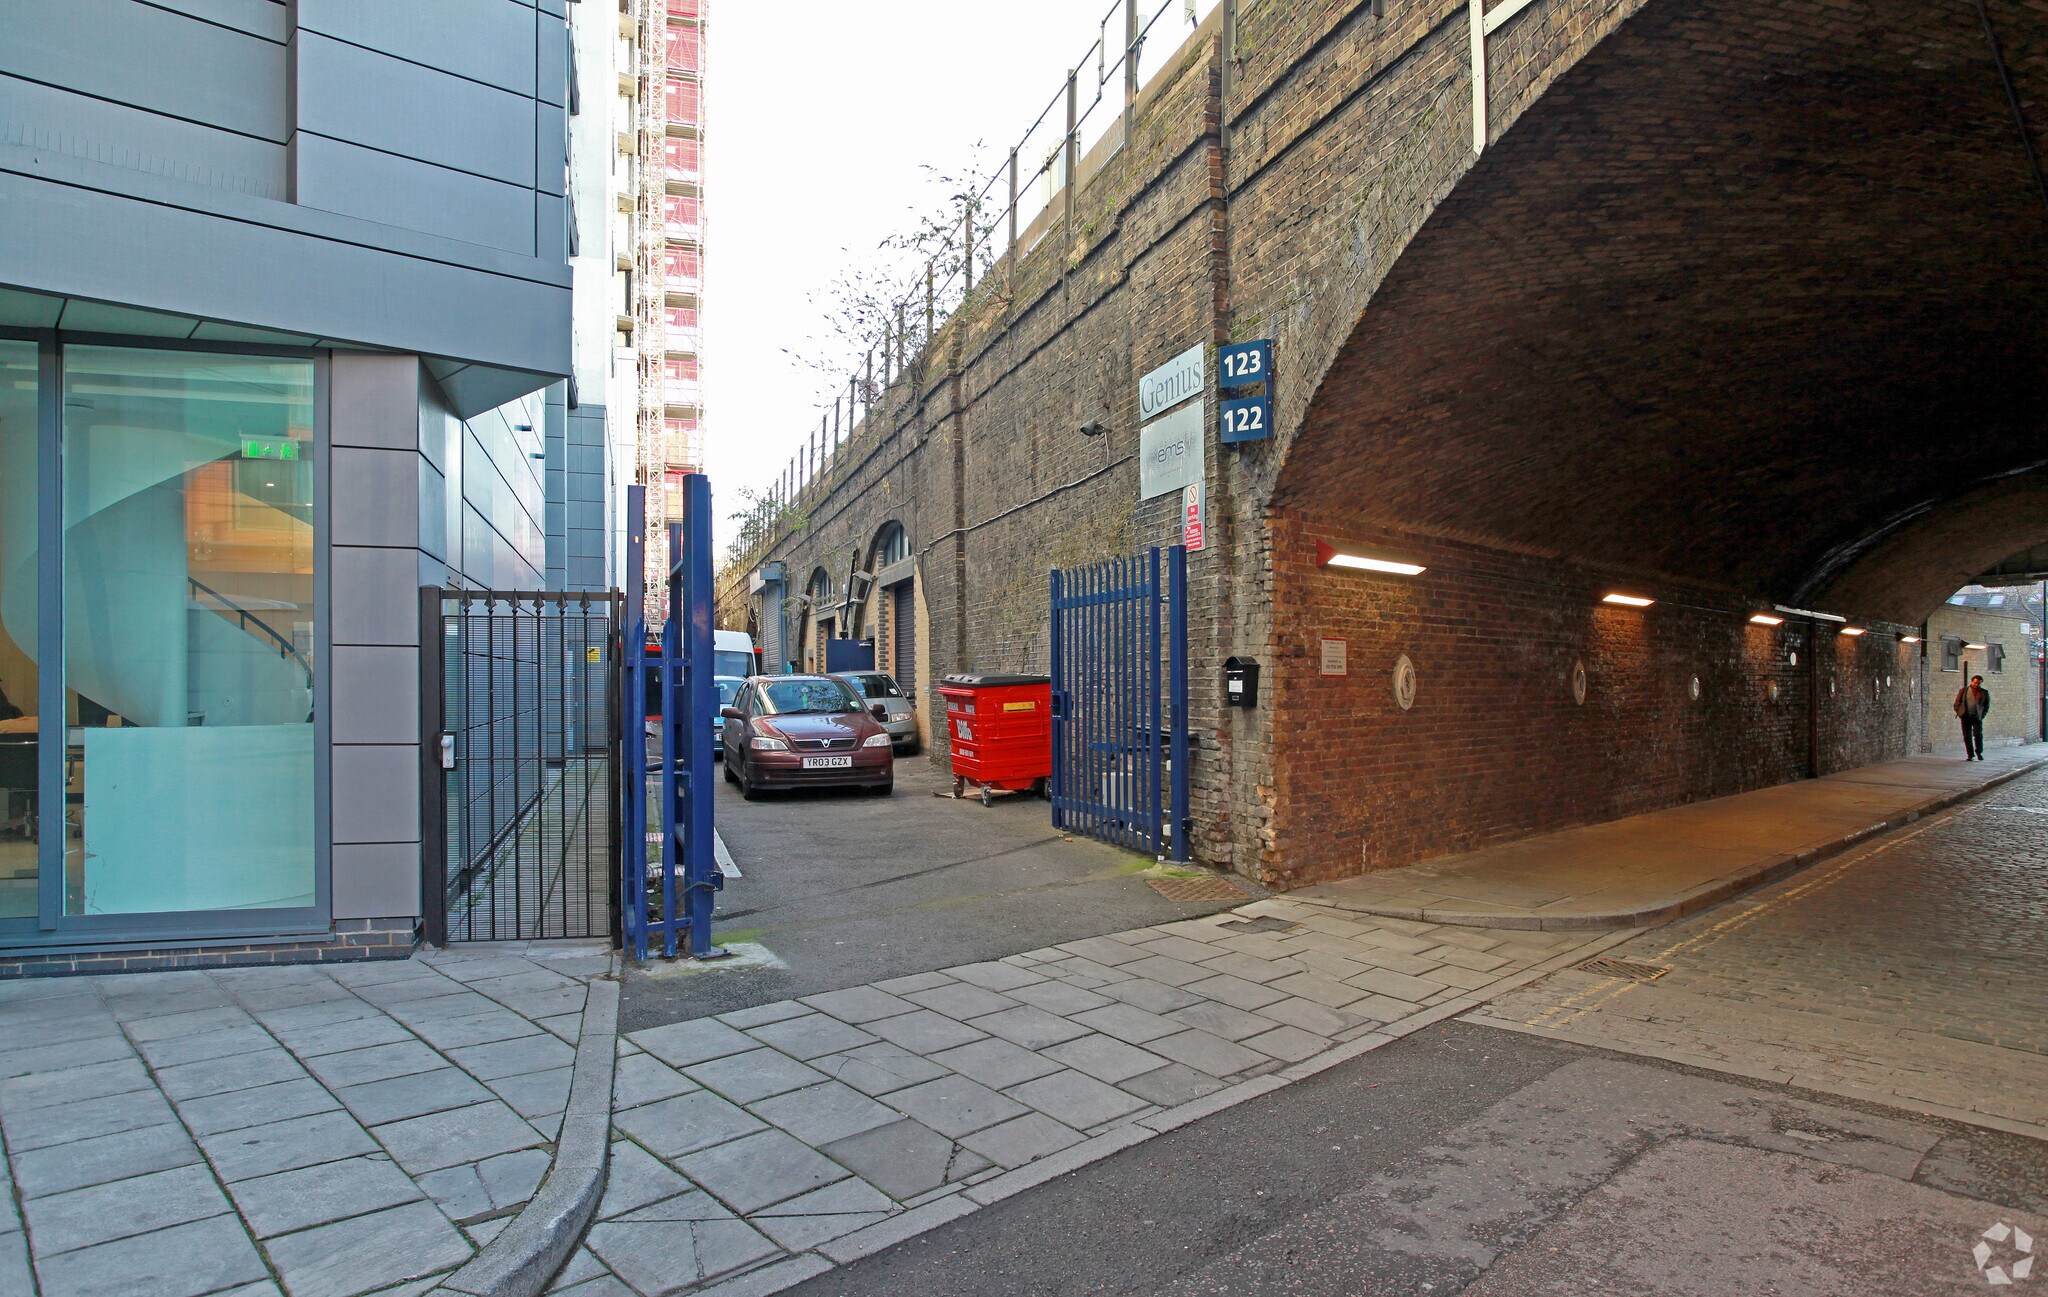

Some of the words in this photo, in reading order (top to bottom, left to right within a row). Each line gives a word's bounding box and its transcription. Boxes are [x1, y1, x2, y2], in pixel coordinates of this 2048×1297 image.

[1224, 350, 1261, 377] 123
[1141, 361, 1201, 413] Genius
[1224, 406, 1263, 432] 122
[1157, 440, 1184, 463] ems
[807, 758, 830, 766] YR03
[831, 757, 848, 766] GZX
